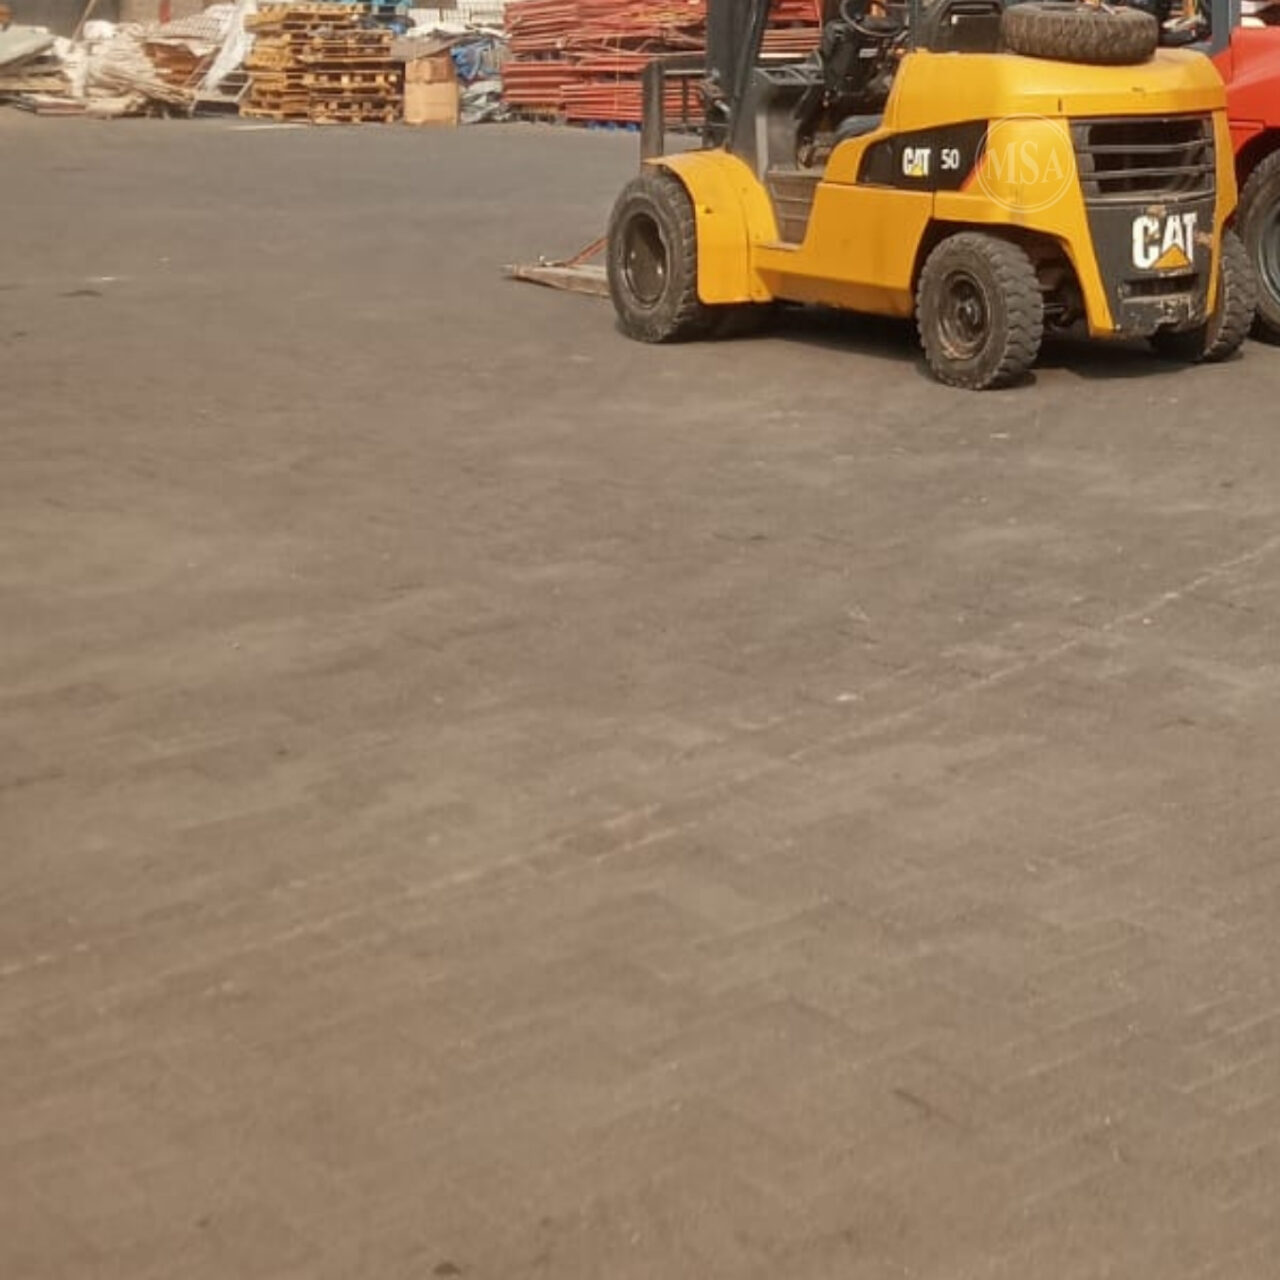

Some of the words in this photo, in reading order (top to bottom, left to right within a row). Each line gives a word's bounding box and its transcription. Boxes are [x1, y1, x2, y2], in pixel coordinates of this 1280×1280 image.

[903, 147, 931, 176] CAT
[940, 148, 959, 170] 50
[1132, 212, 1198, 271] CAT
